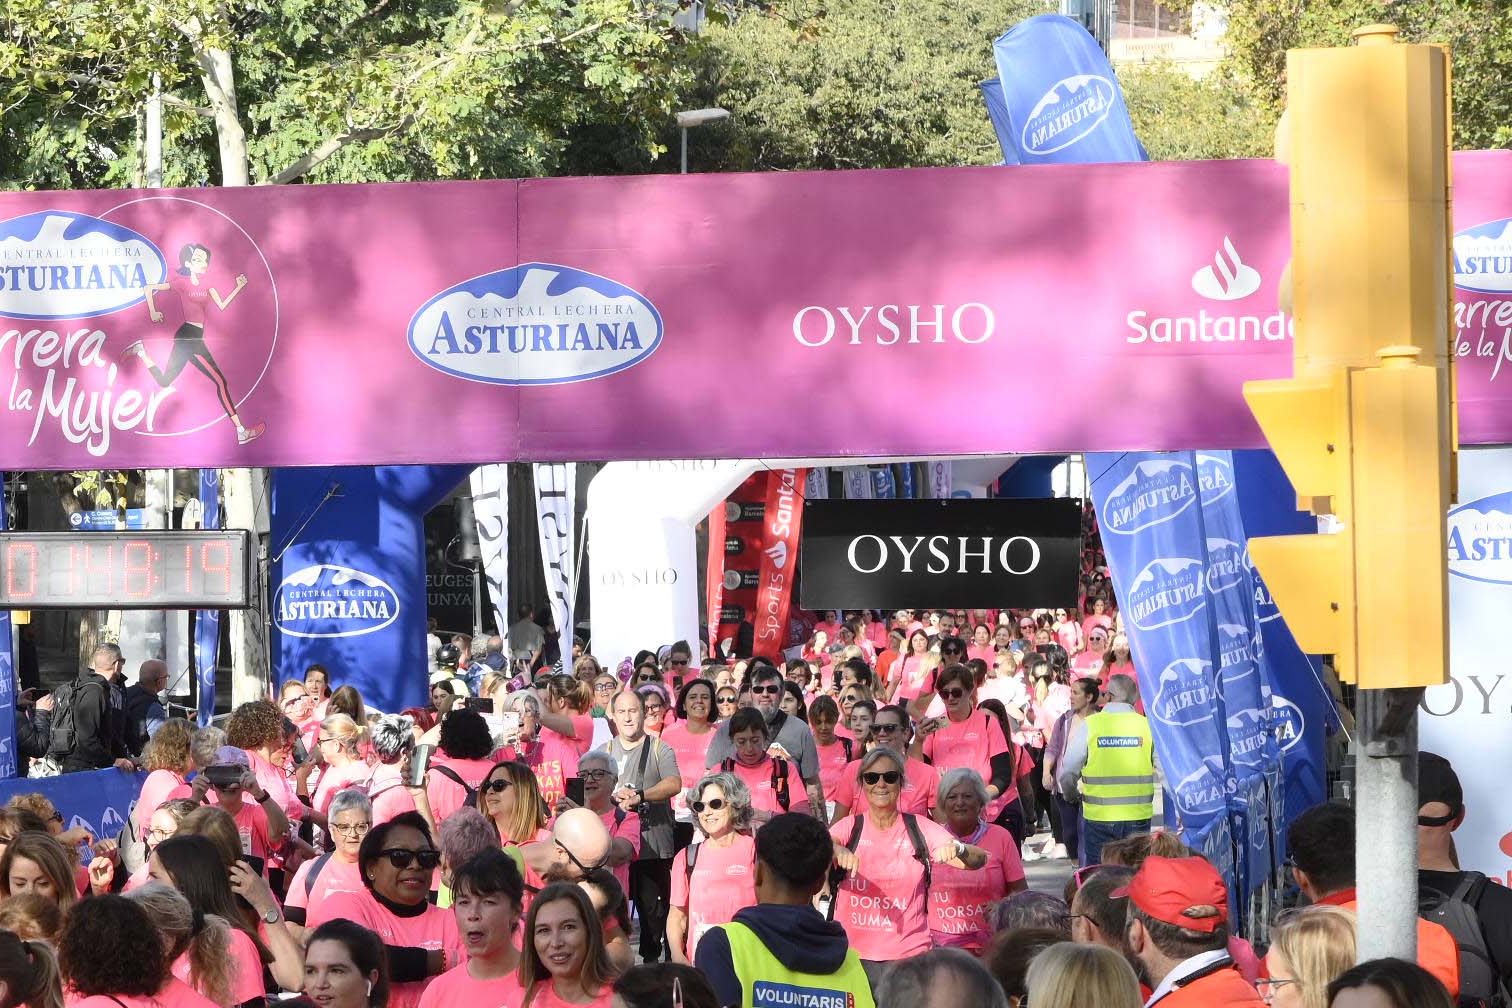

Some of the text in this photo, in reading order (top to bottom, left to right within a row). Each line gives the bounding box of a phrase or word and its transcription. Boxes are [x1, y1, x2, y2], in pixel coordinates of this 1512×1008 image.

[467, 303, 635, 319] CENTRAL LECHERA
[427, 310, 644, 355] ASTURIANA
[792, 302, 996, 347] OYSHO
[8, 371, 33, 412] la
[27, 362, 176, 457] Mujer
[847, 534, 1041, 575] OYSHO
[289, 588, 386, 599] CENTRAL LECHERA
[277, 594, 391, 623] ASTURIANA
[759, 571, 784, 641] Sports
[1097, 737, 1138, 747] VOLUNTARIS
[849, 878, 867, 892] TU
[850, 895, 908, 910] DORSAL
[934, 891, 949, 903] TU
[851, 912, 892, 927] SUMA
